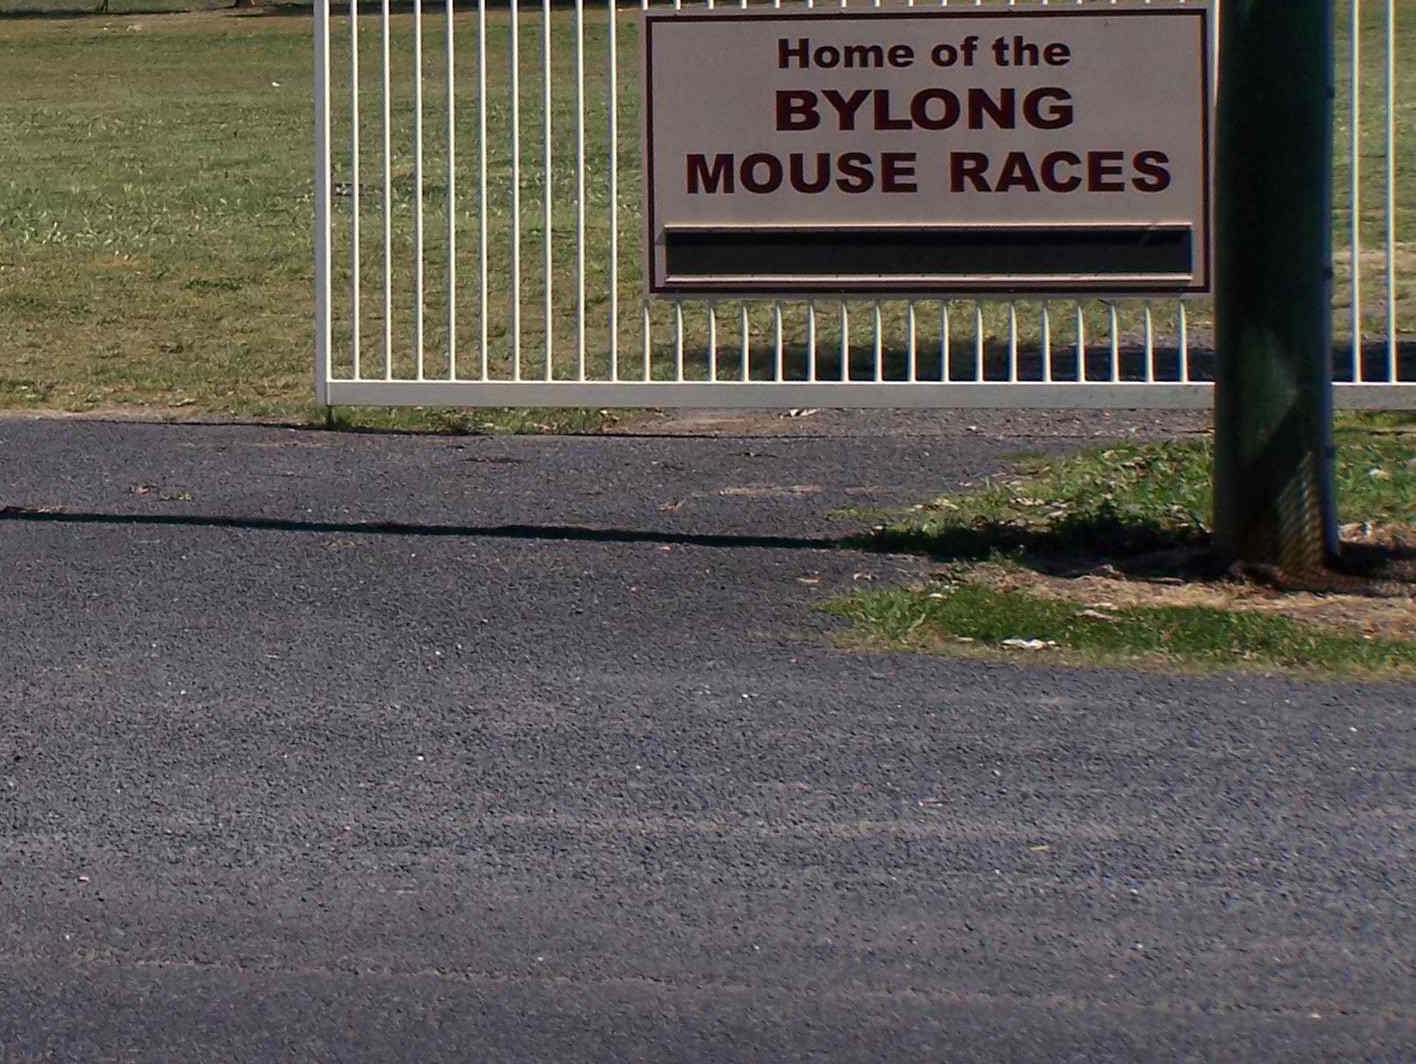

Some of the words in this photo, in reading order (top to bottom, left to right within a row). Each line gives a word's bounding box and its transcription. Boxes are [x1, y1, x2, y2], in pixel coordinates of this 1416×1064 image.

[777, 38, 915, 69] Home
[930, 36, 979, 68] of
[992, 35, 1072, 67] the
[775, 86, 1074, 132] BYLONG
[686, 151, 918, 195] MOUSE
[949, 150, 1172, 194] RACES
